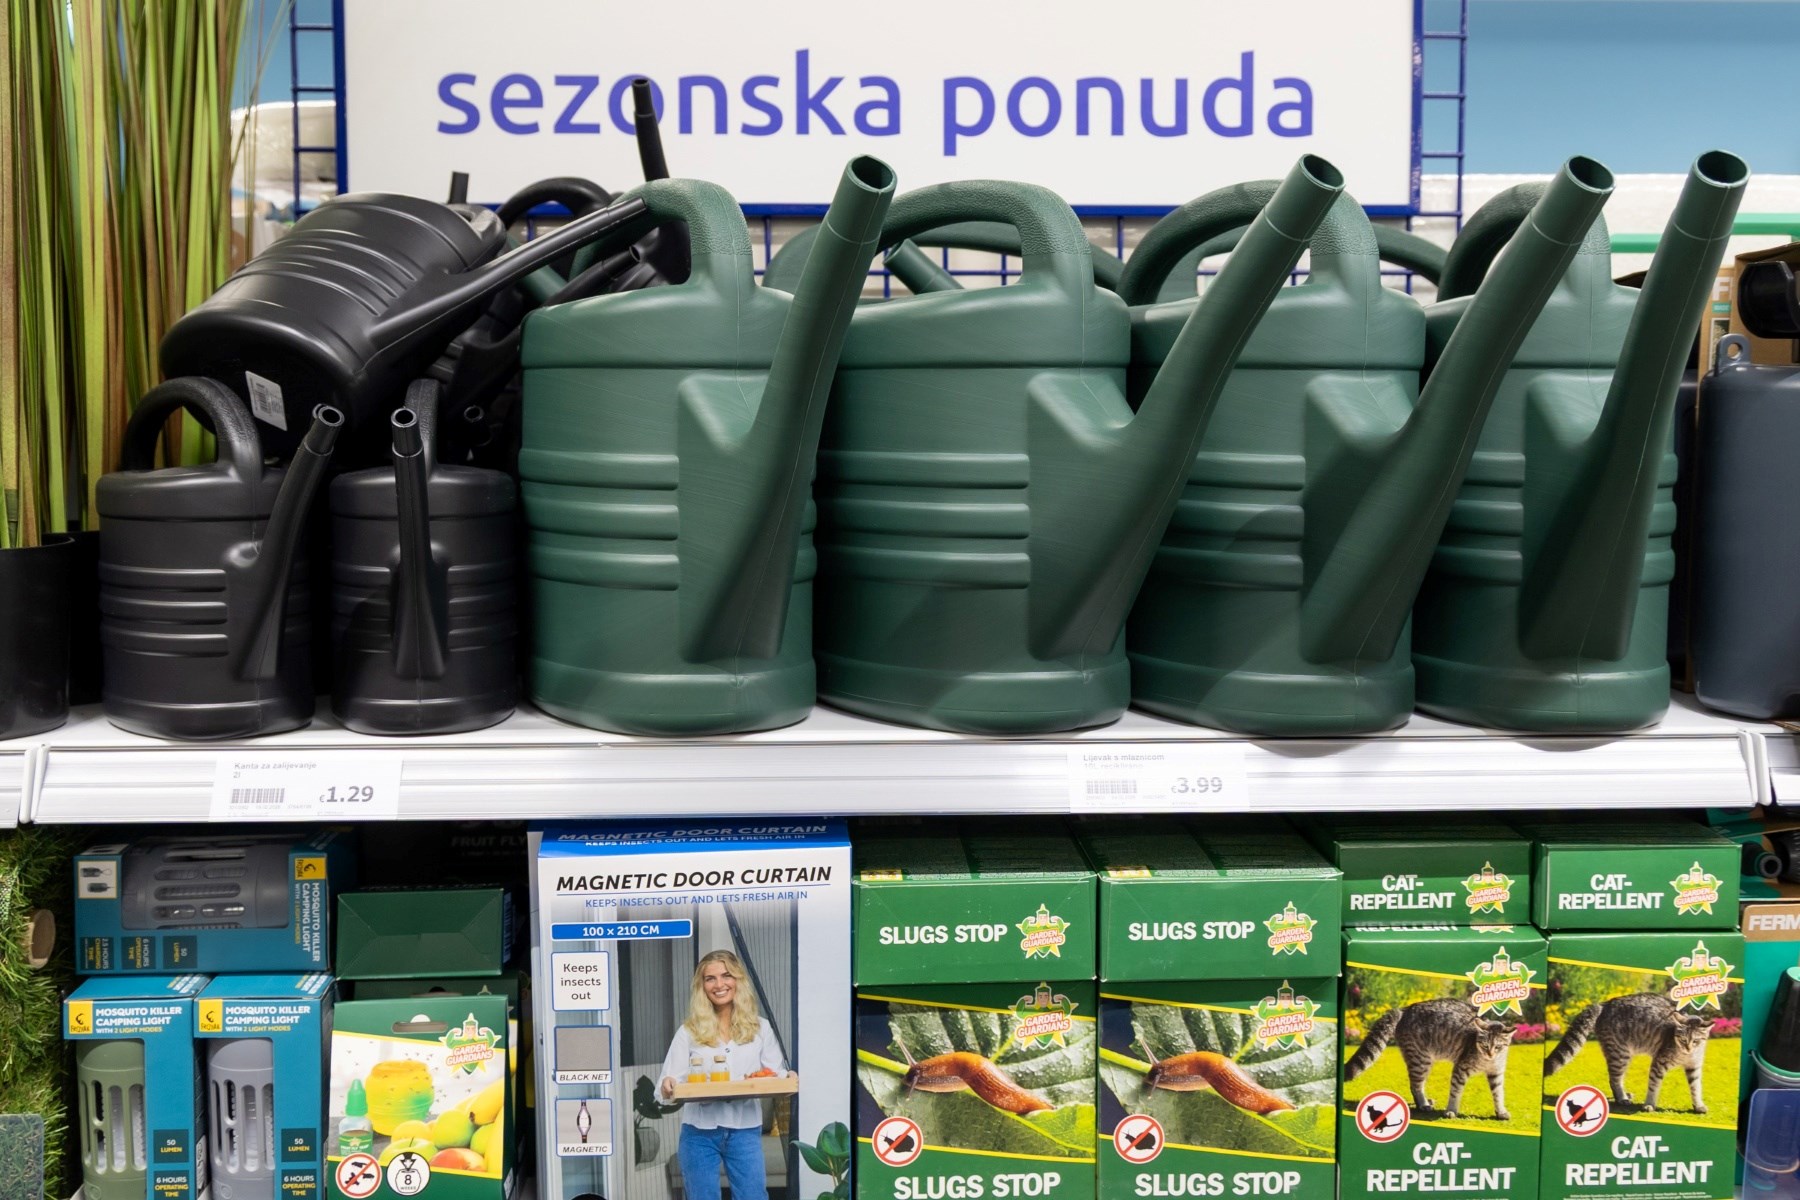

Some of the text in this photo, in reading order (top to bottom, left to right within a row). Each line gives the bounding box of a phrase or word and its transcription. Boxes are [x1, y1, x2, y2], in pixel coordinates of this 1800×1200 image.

[437, 49, 1314, 156] sezonska ponuda
[234, 762, 259, 770] Kanta
[272, 762, 317, 770] zalijevanje
[558, 825, 826, 841] MAGNETIC DOOR CURTAIN
[556, 866, 832, 892] MAGNETIC DOOR CURTAIN
[1382, 874, 1423, 891] CAT-
[1590, 874, 1632, 891] CAT-
[585, 890, 807, 908] KEEPS INSECTS OUT AND LETS FRESH AIR IN
[1468, 892, 1509, 905] GUARDIANS
[1474, 887, 1503, 897] GARDEN
[1675, 892, 1717, 905] GUARDIANS
[1682, 887, 1711, 897] GARDEN
[1350, 893, 1455, 911] REPELLENT
[1558, 893, 1664, 911] REPELLENT
[302, 882, 310, 952] CAMPING LIGHT
[311, 882, 321, 962] MOSQUITO KILLER
[582, 926, 605, 937] 100
[617, 926, 638, 936] 210
[640, 925, 660, 935] CM
[879, 924, 1008, 945] SLUGS STOP
[1029, 929, 1059, 940] GARDEN
[1128, 921, 1255, 941] SLUGS STOP
[1278, 926, 1307, 937] GARDEN
[1022, 935, 1064, 949] GUARDIANS
[1270, 932, 1312, 946] GUARDIANS
[142, 944, 150, 967] HOURS
[563, 962, 598, 975] Keeps
[561, 976, 601, 987] insects
[1482, 979, 1520, 993] GARDEN
[1682, 973, 1719, 988] GARDEN
[571, 991, 591, 1001] out
[1474, 987, 1528, 1003] GUARDIANS
[1673, 981, 1727, 999] GUARDIANS
[96, 1006, 182, 1017] MOSQUITO KILLER
[226, 1005, 311, 1015] MOSQUITO KILLER
[96, 1017, 172, 1027] CAMPING LIGHT
[226, 1015, 300, 1024] CAMPING LIGHT
[1025, 1012, 1062, 1027] GARDEN
[1268, 1012, 1305, 1027] GARDEN
[1016, 1020, 1070, 1038] GUARDIANS
[1259, 1020, 1312, 1039] GUARDIANS
[453, 1043, 487, 1056] GARDEN
[447, 1051, 493, 1065] GUARDIANS
[559, 1073, 609, 1082] BLACK NET
[562, 1145, 608, 1153] MAGNETIC
[1412, 1143, 1471, 1165] CAT-
[1611, 1136, 1669, 1159] CAT-
[404, 1174, 412, 1185] 8
[1367, 1167, 1516, 1192] REPELLENT
[1565, 1161, 1713, 1186] REPELLENT
[894, 1173, 1061, 1200] SLUGS STOP
[1135, 1172, 1301, 1198] SLUGS STOP
